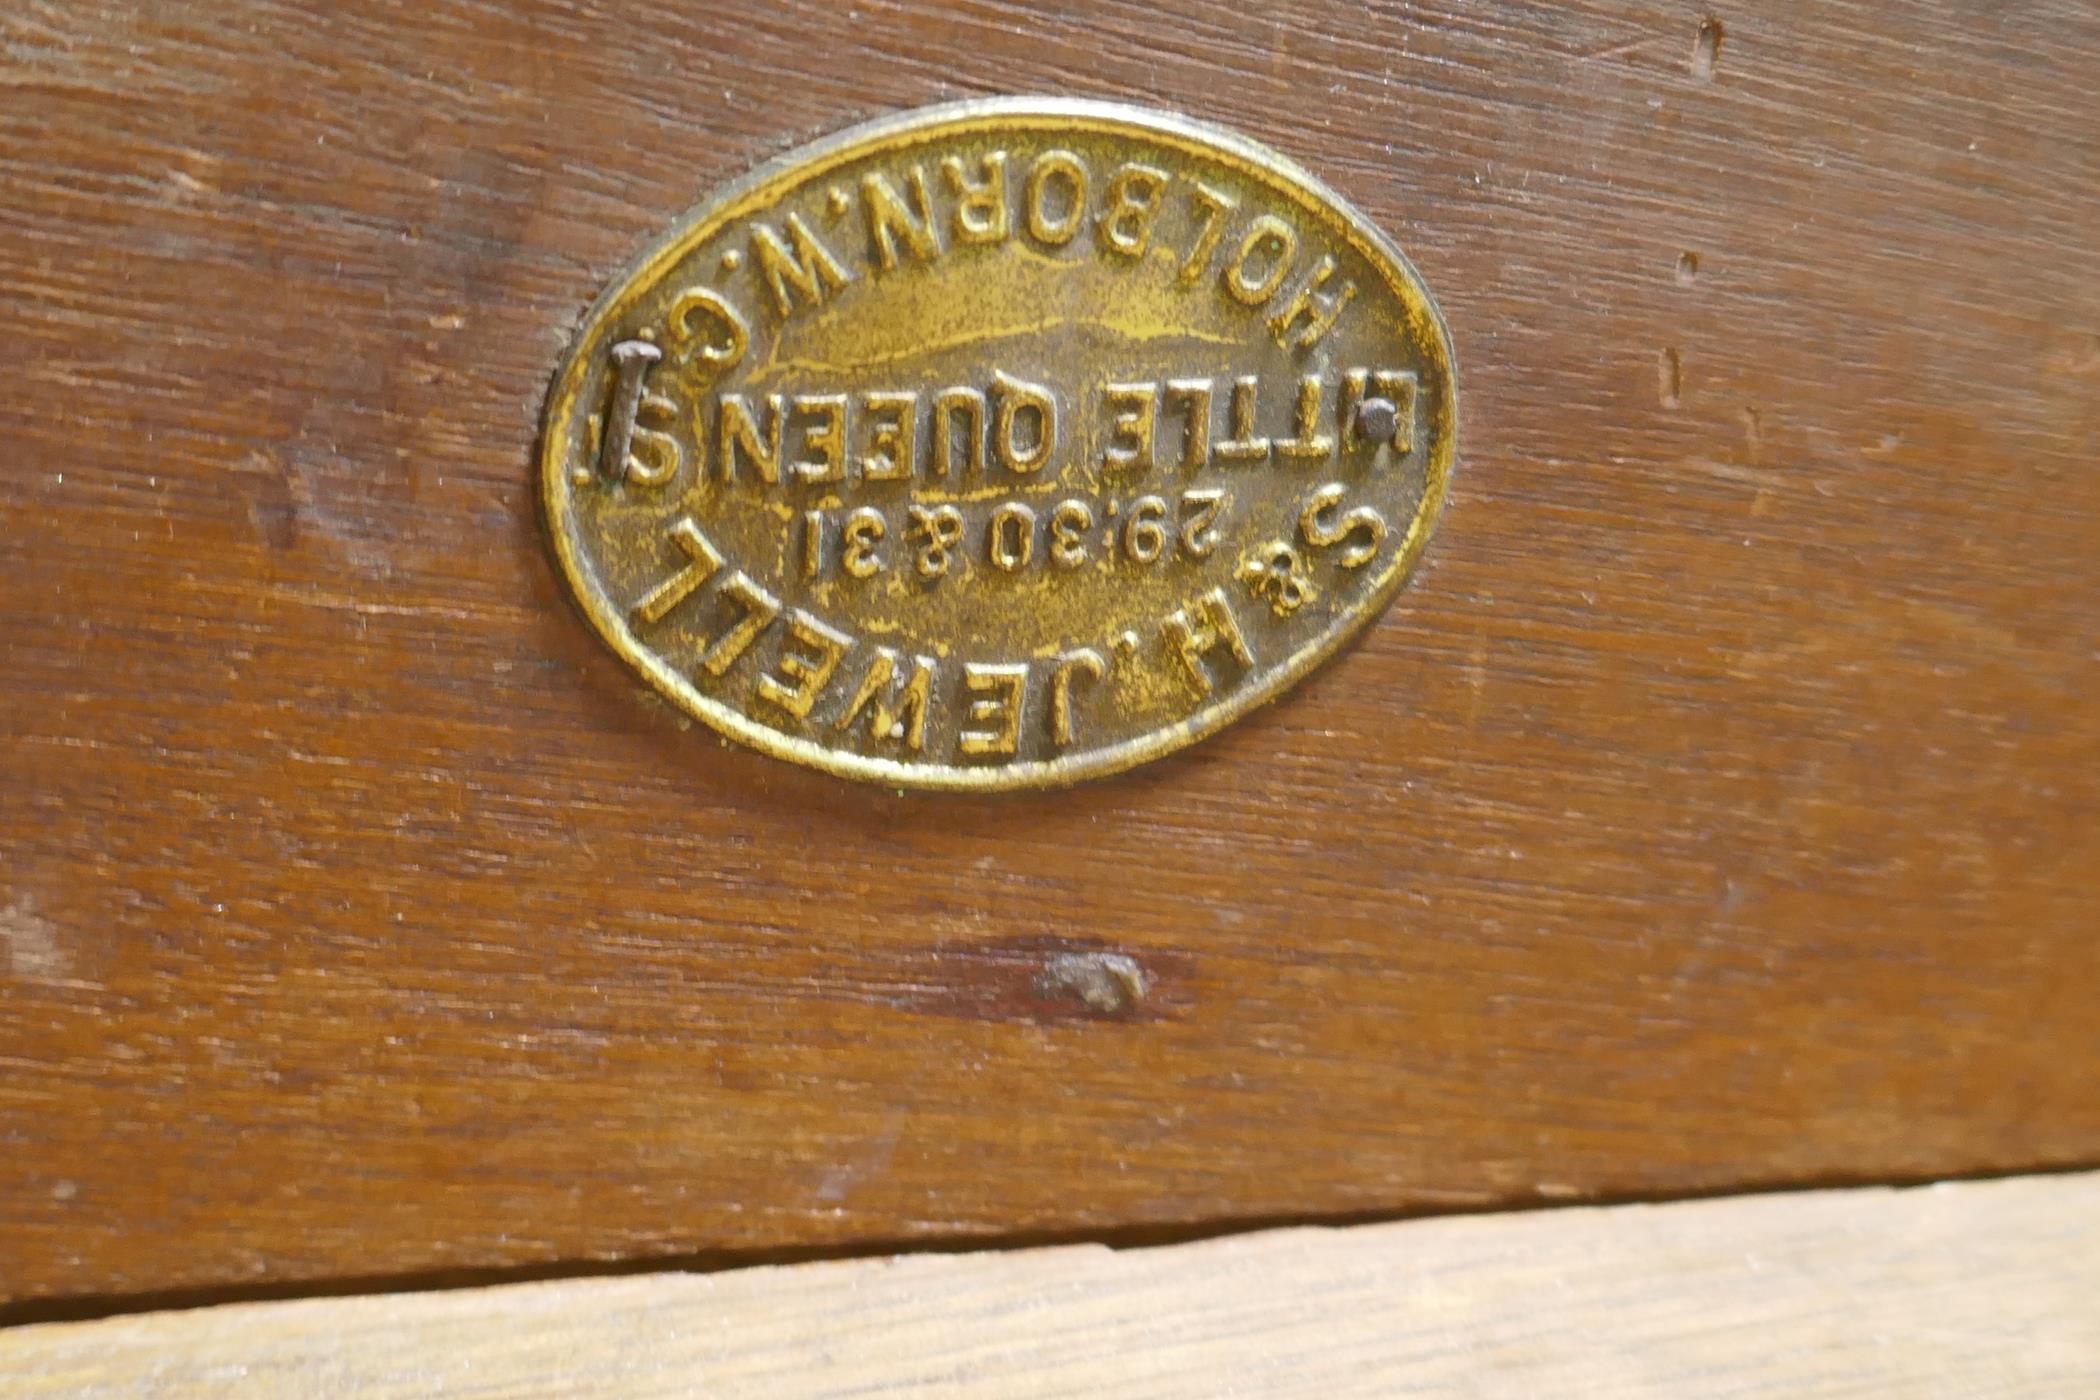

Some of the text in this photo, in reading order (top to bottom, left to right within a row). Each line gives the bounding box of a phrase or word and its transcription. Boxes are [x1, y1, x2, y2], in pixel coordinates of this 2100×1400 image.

[719, 366, 1057, 484] QUEEN
[1100, 366, 1418, 470] LITTLE
[805, 505, 886, 578] 31
[904, 504, 965, 577] &
[1301, 482, 1388, 568] S
[1233, 539, 1316, 618] &
[631, 516, 1106, 754] JEWELL
